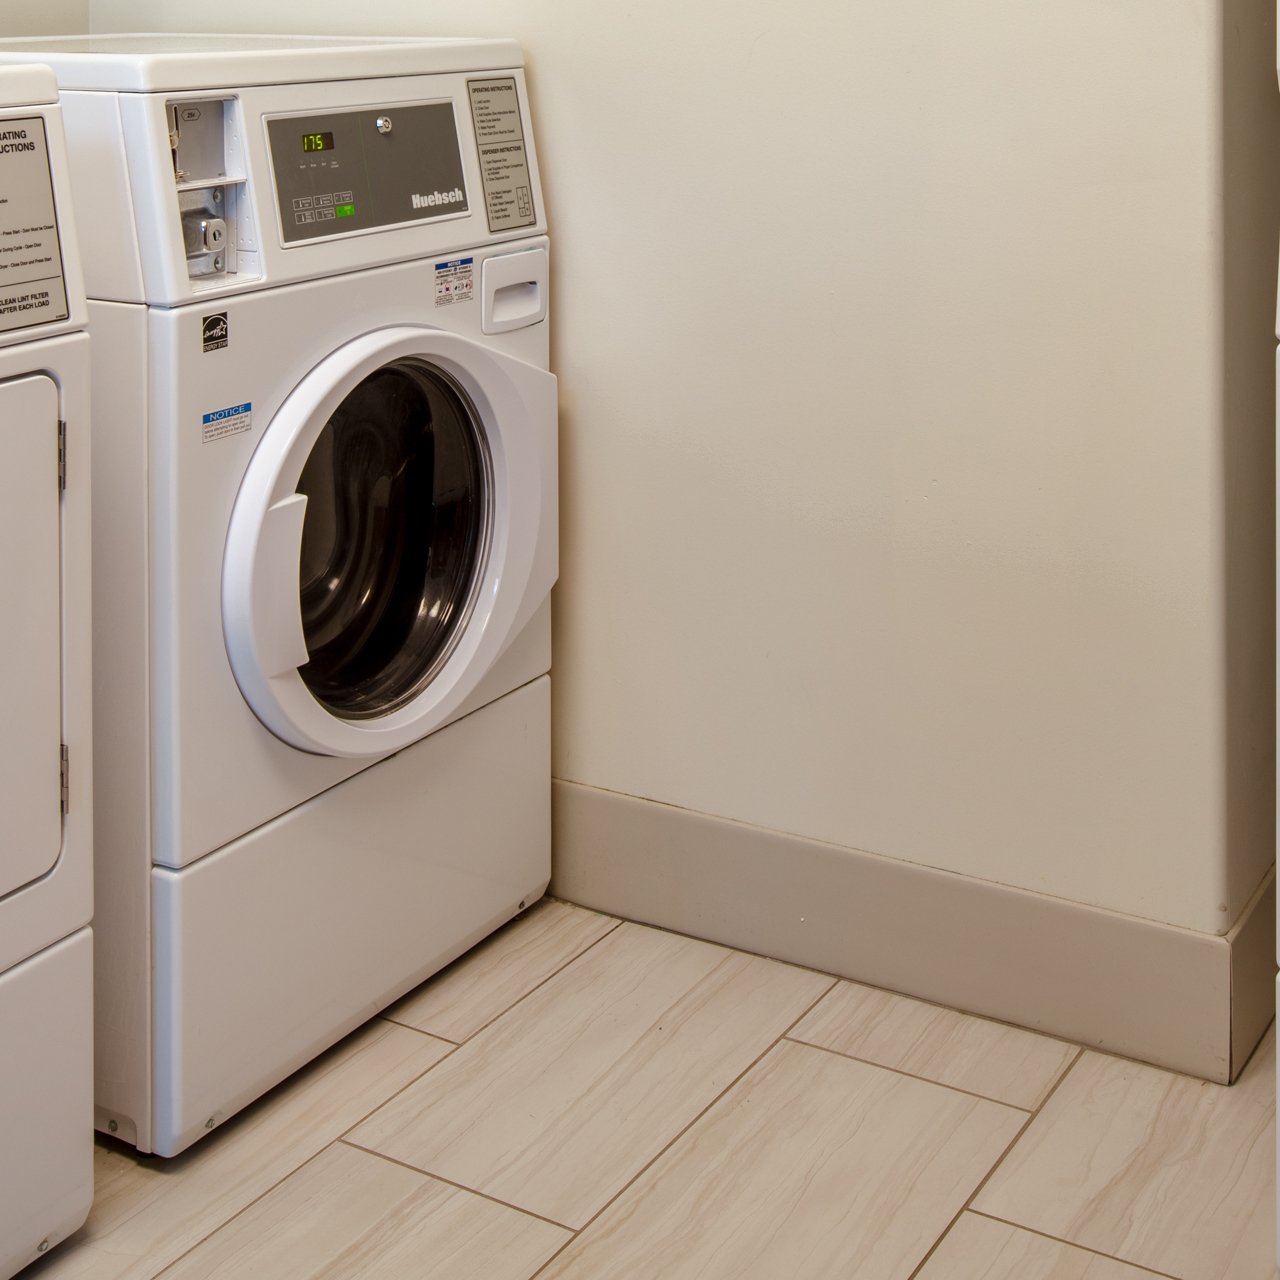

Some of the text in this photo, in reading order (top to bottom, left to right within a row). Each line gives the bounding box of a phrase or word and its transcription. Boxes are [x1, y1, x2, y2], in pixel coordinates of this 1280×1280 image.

[304, 135, 323, 150] 175
[411, 188, 463, 208] Huebsch
[17, 293, 29, 303] LINT
[31, 291, 49, 301] FILTER
[0, 300, 49, 315] AFTER EACH LOAD
[209, 405, 245, 421] NOTICE
